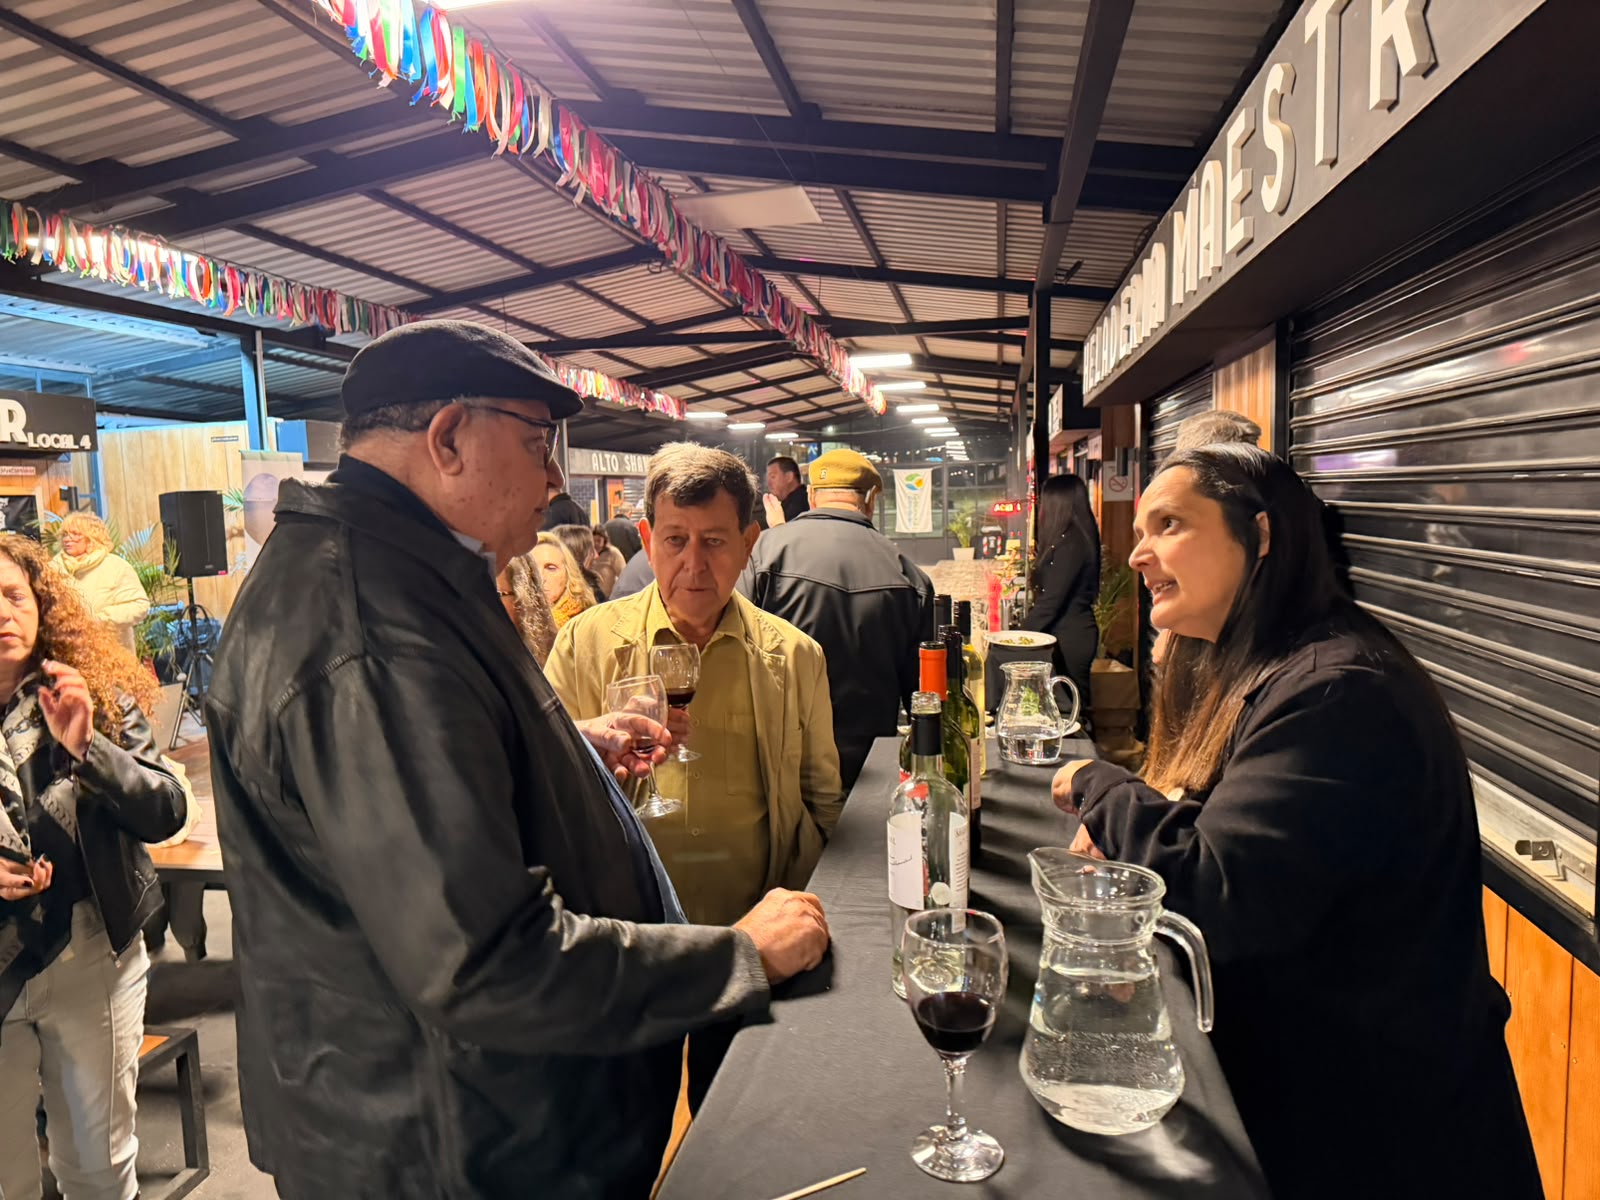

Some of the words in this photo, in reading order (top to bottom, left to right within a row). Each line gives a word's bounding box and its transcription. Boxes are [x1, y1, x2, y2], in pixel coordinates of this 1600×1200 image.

[27, 432, 79, 449] LOCAL
[80, 434, 92, 450] 4
[592, 452, 619, 472] ALTO
